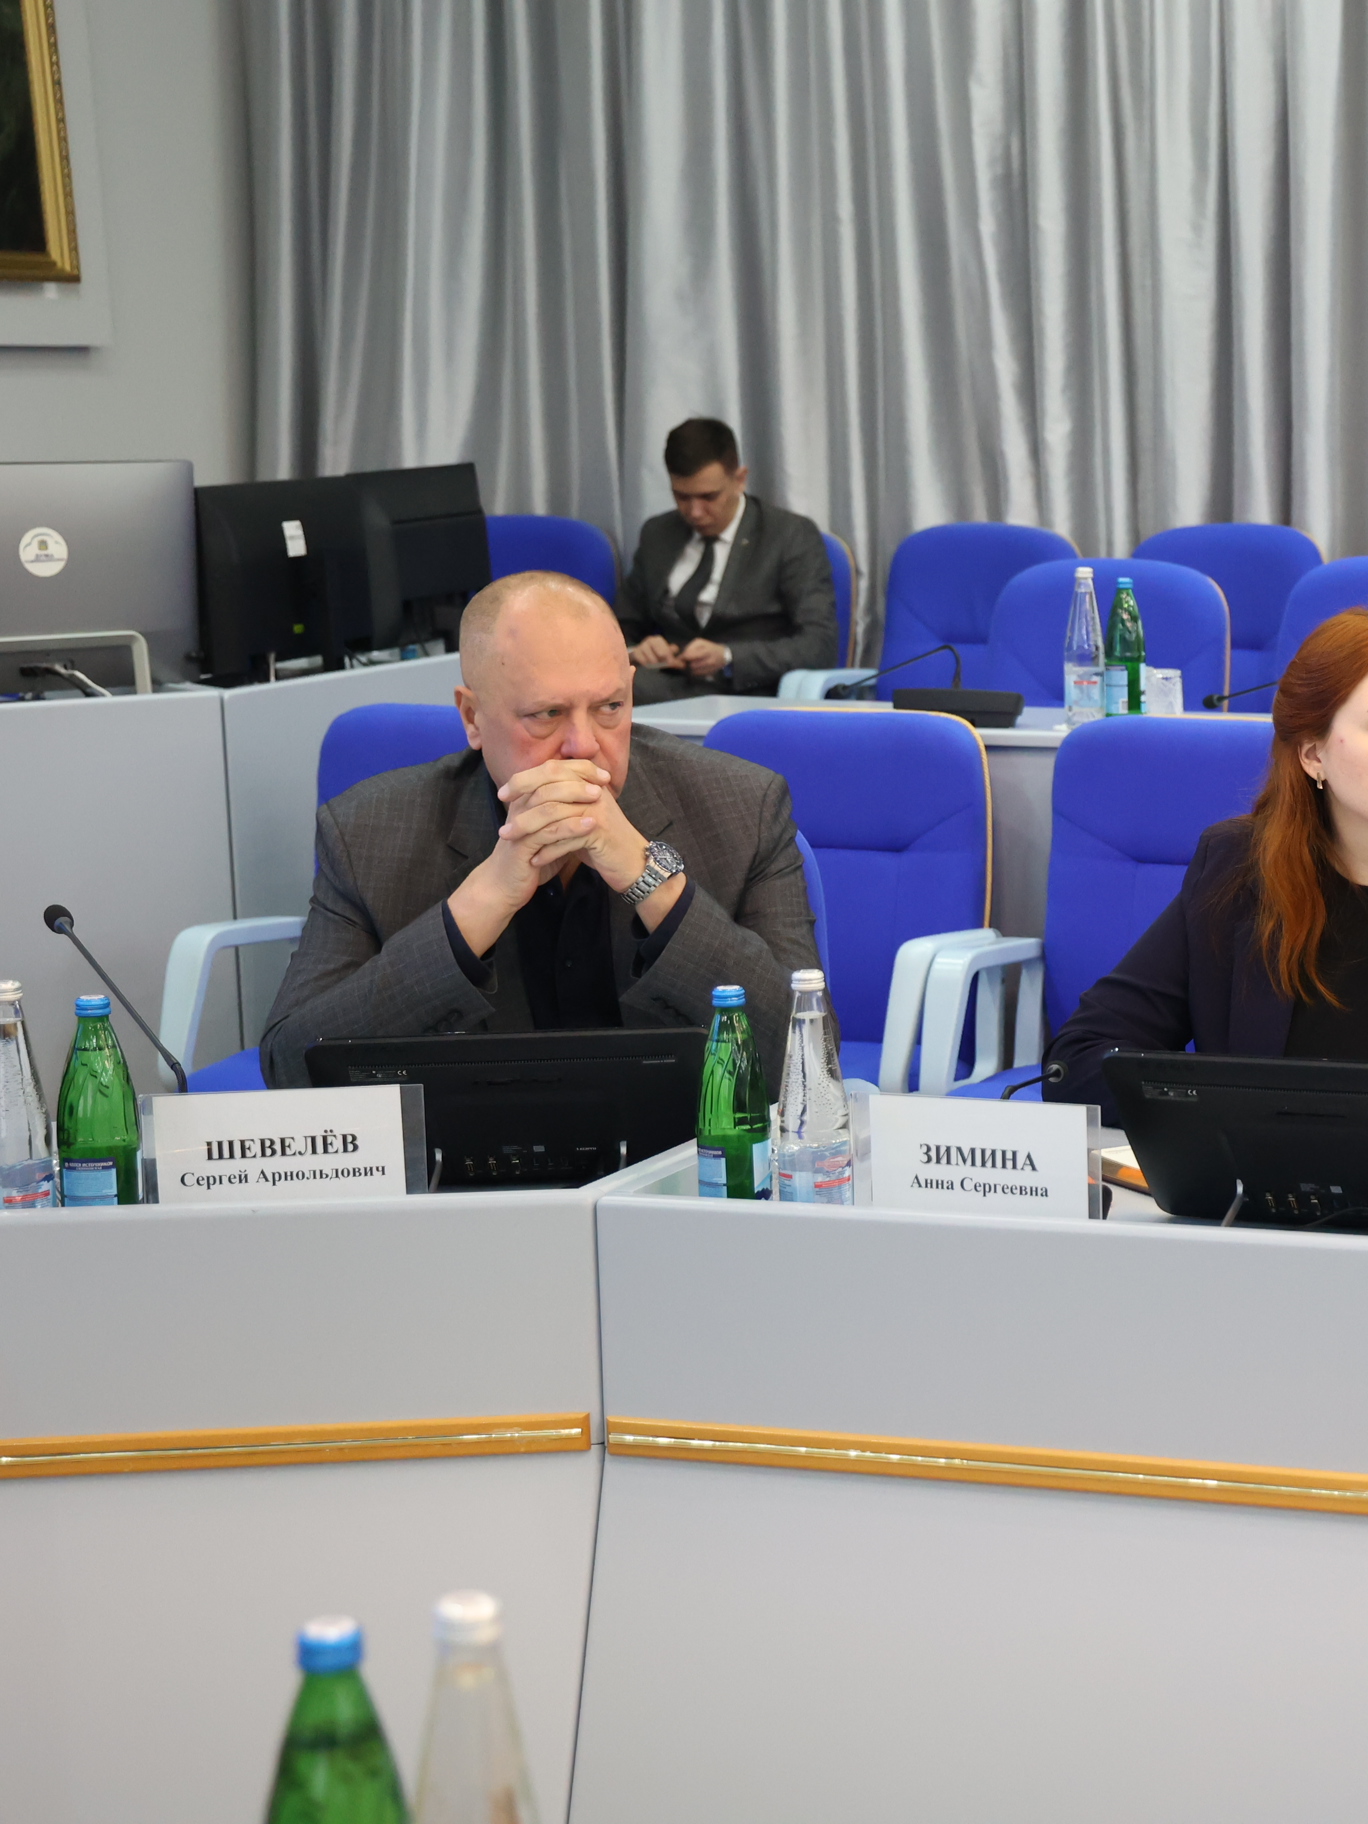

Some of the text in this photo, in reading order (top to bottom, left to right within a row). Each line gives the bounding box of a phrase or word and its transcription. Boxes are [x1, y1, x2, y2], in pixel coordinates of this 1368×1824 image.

[205, 1128, 360, 1161] ШЕВЕЛЁВ
[918, 1142, 1039, 1172] ЗИМИНА
[179, 1164, 387, 1191] Сергей Арнольдович
[910, 1173, 1049, 1198] Анна Сергеевна
